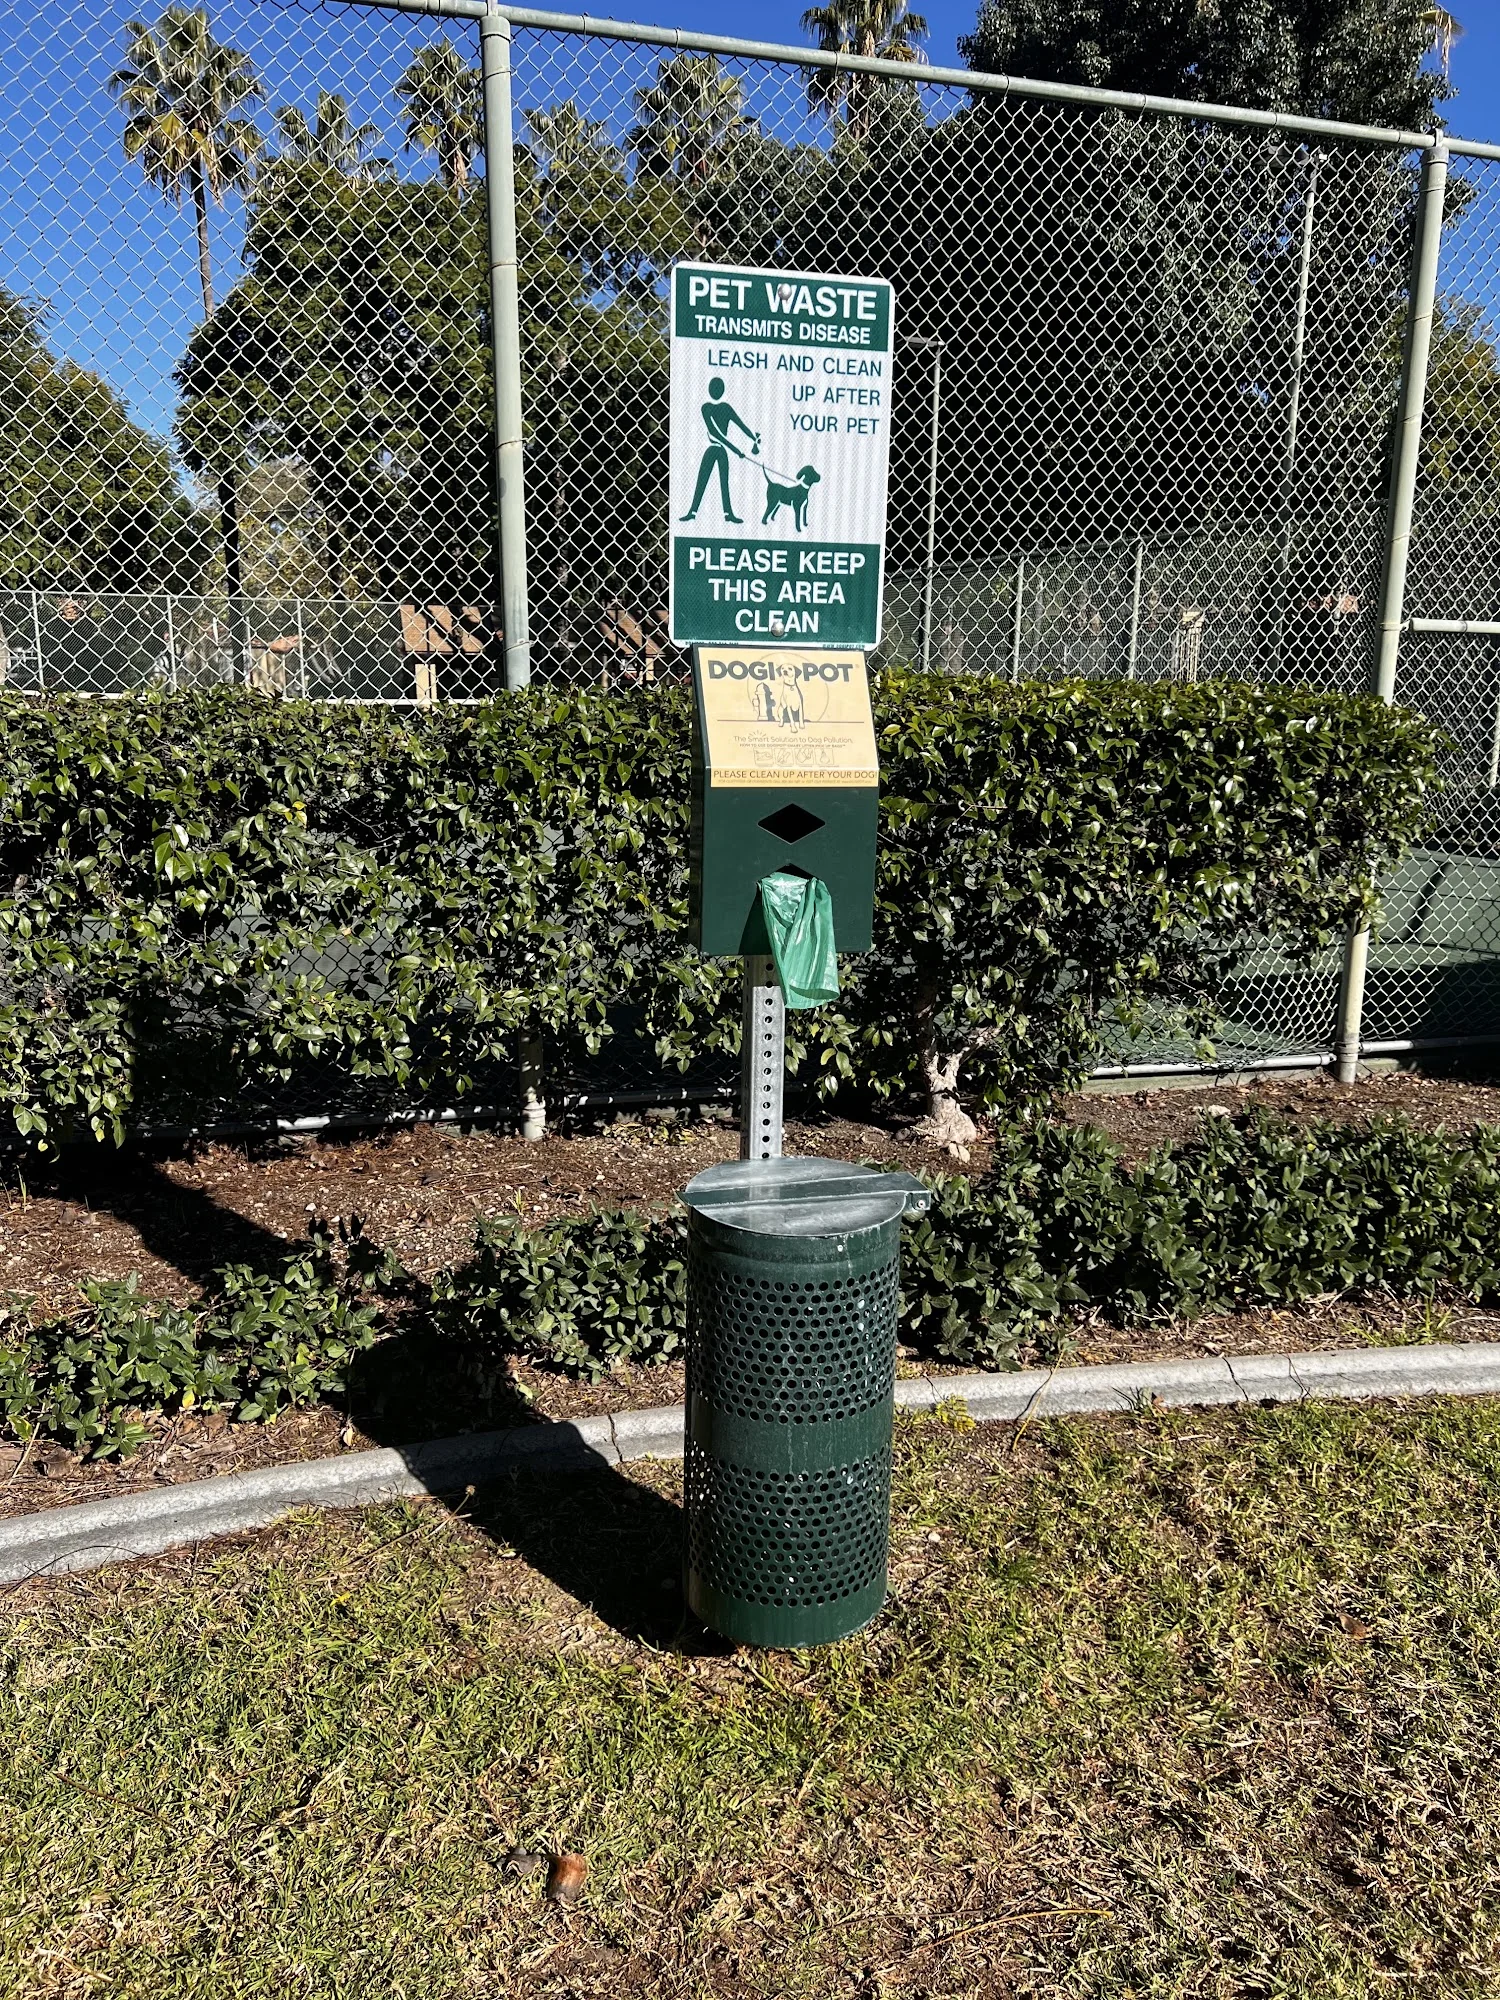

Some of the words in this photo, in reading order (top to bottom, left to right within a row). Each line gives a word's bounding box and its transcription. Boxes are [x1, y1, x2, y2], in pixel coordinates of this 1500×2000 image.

[689, 275, 752, 311] PET
[765, 282, 877, 321] WASTE
[694, 314, 793, 340] TRANSMITS
[799, 323, 871, 345] DISEASE
[708, 349, 768, 370] LEASH
[776, 354, 814, 372] AND
[823, 357, 882, 377] CLEAN
[792, 384, 816, 401] UP
[823, 387, 881, 406] AFTER
[789, 413, 838, 433] YOUR
[847, 418, 880, 435] PET
[689, 546, 788, 573] PLEASE
[799, 551, 866, 575] KEEP
[708, 578, 767, 603] THIS
[777, 580, 846, 605] AREA
[735, 608, 819, 634] CLEAN
[734, 735, 747, 743] The
[748, 735, 770, 743] Smart
[808, 737, 822, 745] Dog
[713, 770, 747, 779] PLEASE
[749, 770, 781, 779] CLEAN
[782, 770, 795, 779] UP
[797, 770, 825, 779] AFTER
[827, 770, 852, 779] YOUR
